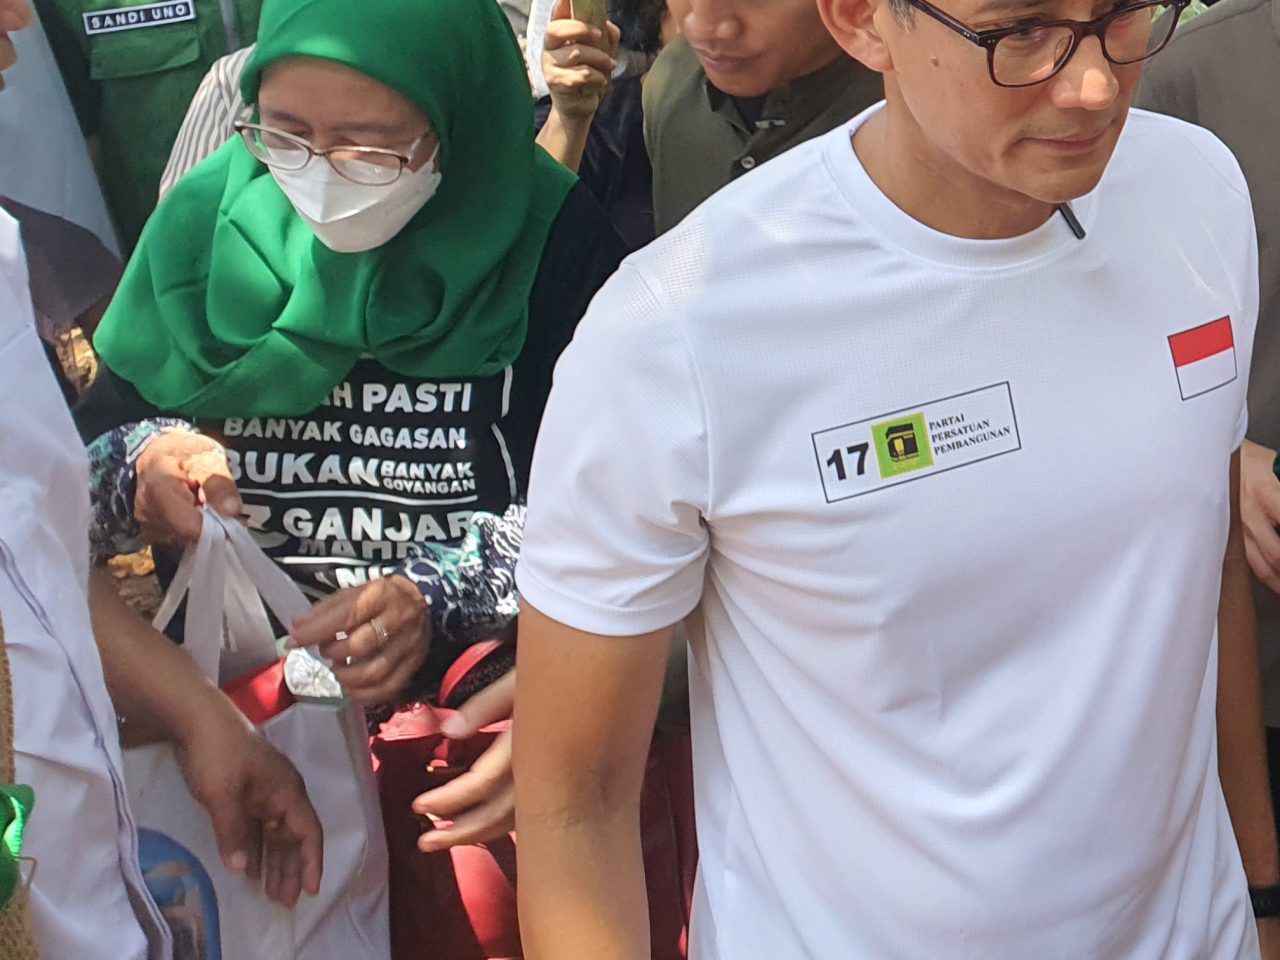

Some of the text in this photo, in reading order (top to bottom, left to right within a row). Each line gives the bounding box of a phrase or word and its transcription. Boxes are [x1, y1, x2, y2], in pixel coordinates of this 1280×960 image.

[91, 4, 188, 30] SANDI UNO
[362, 382, 473, 413] PASTI
[223, 417, 467, 450] BANYAK GAGASAN
[929, 413, 965, 431] PARTAI
[931, 419, 990, 443] PERSATUAN
[934, 425, 1011, 456] PEMBANGUNAN
[226, 450, 475, 489] BUKAN BANYAK
[826, 441, 870, 481] 17
[282, 507, 476, 542] GANJAR
